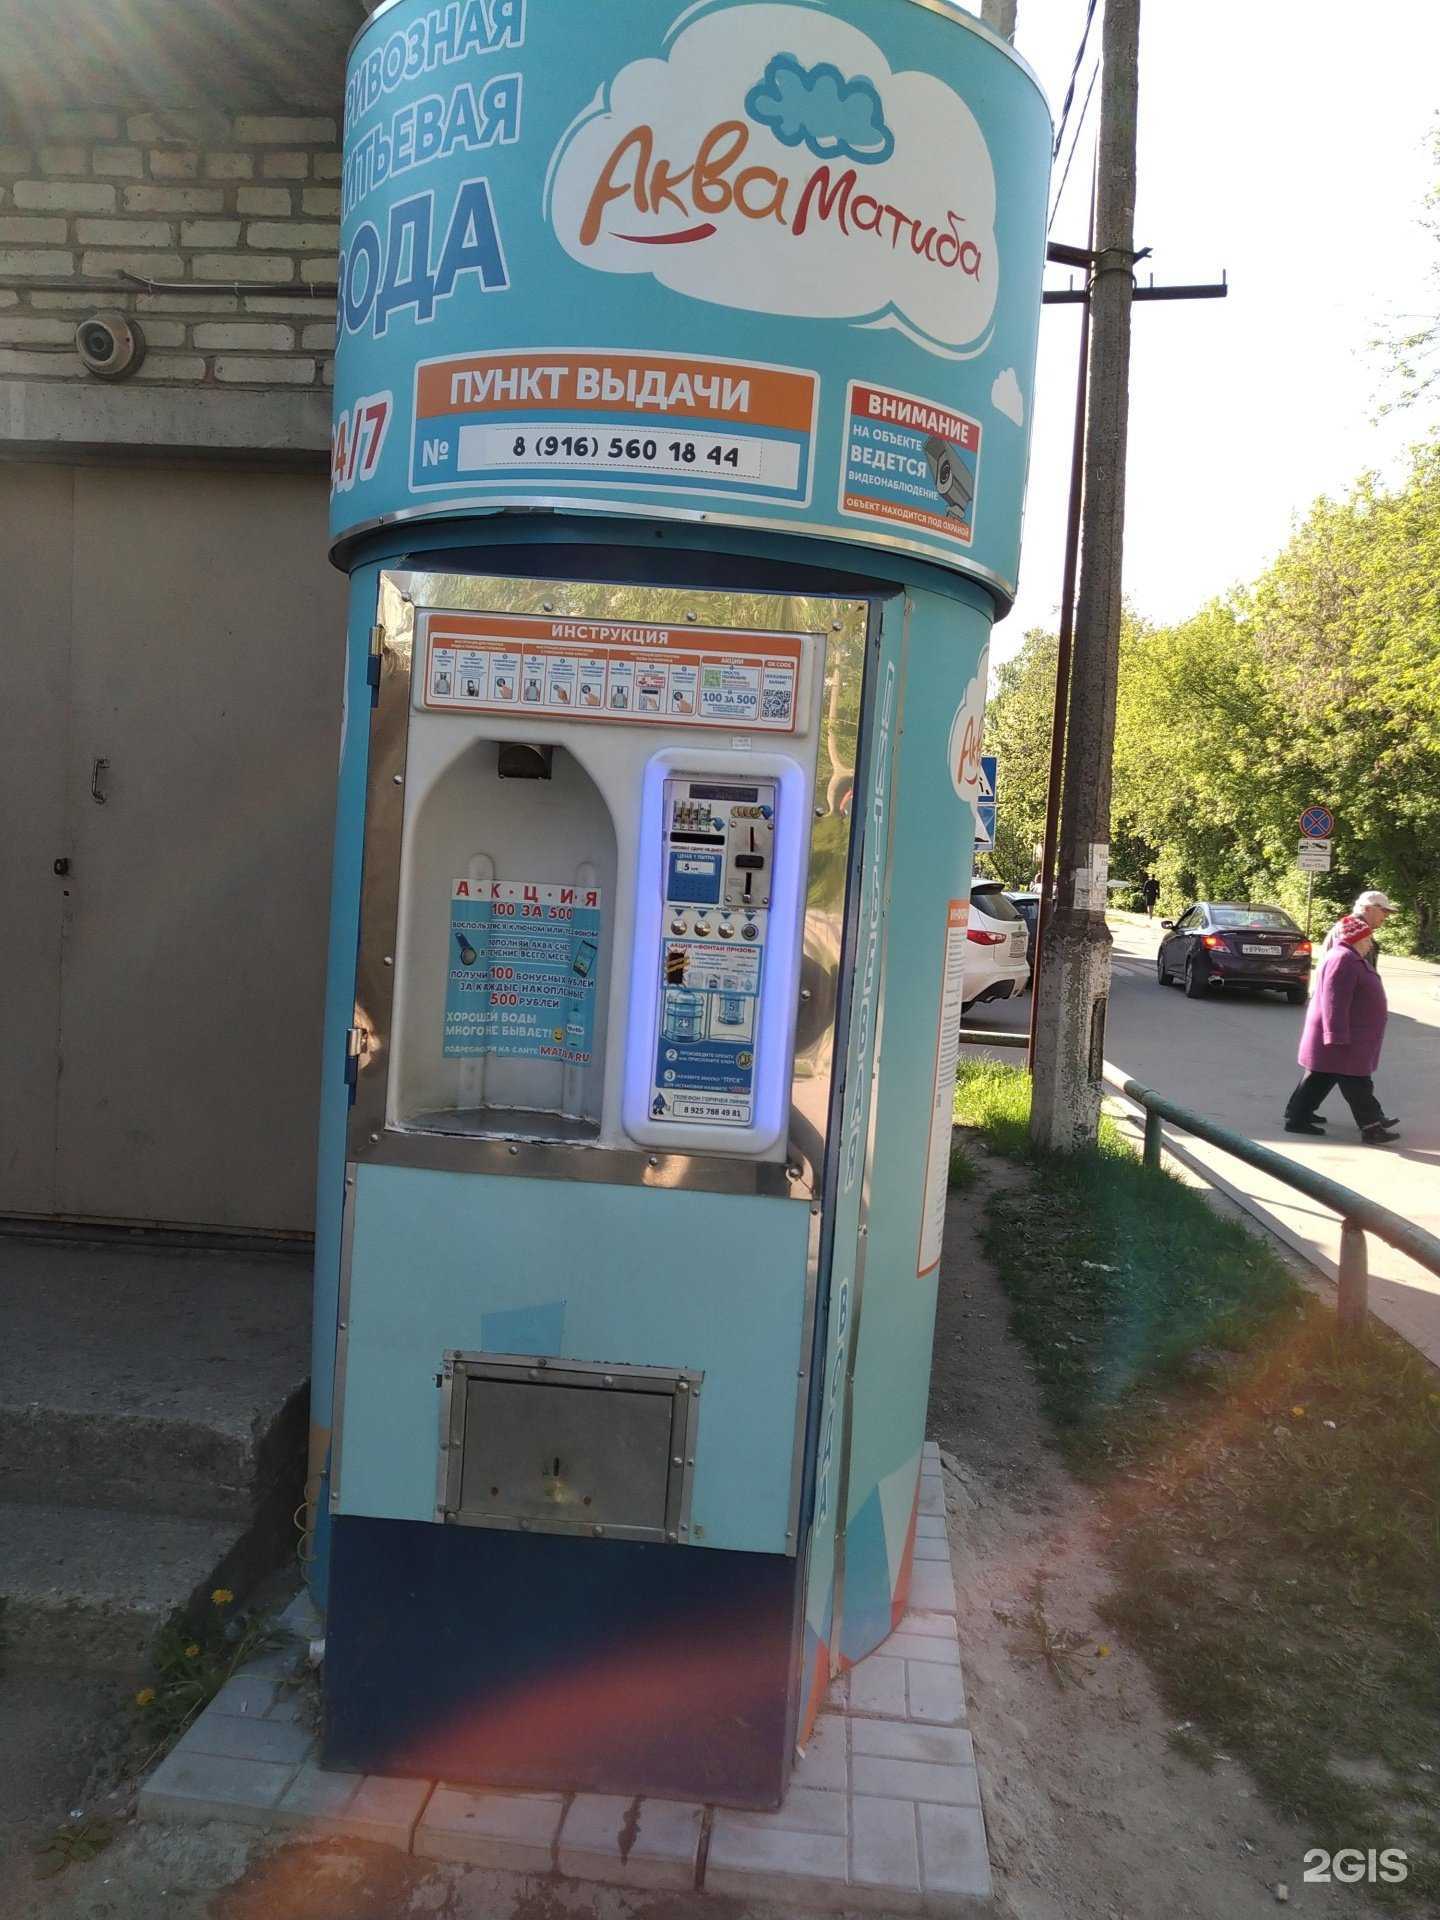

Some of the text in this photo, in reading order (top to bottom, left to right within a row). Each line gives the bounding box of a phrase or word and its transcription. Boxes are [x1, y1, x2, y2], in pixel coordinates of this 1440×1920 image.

[451, 367, 750, 413] ПУНКТ ВЫДАЧИ
[868, 393, 969, 444] ВНИМАНИЕ
[331, 391, 393, 494] 4/7
[853, 424, 923, 451] НА ОБЪЕКТЕ
[422, 436, 739, 467] № 8 (916) 560 18 44
[851, 445, 927, 478] ВЕДЕТСЯ
[848, 470, 939, 501] ВИДЕОНАБЛЮДЕНИЕ
[846, 498, 880, 512] ОБЪЕКТ
[881, 503, 927, 523] НАХОДИТСЯ
[551, 624, 669, 645] ИНСТРУКЦИЯ
[703, 692, 757, 705] 100 ЗА 500
[684, 863, 690, 871] 5
[493, 903, 573, 920] 100 ЗА 500
[451, 970, 488, 979] ПОЛУЧИ
[489, 967, 513, 980] 100
[489, 993, 517, 1005] 500
[501, 1012, 537, 1023] ВОДЫ
[446, 1026, 486, 1036] МНОГО
[488, 1026, 499, 1036] НЕ
[690, 1106, 704, 1114] 925
